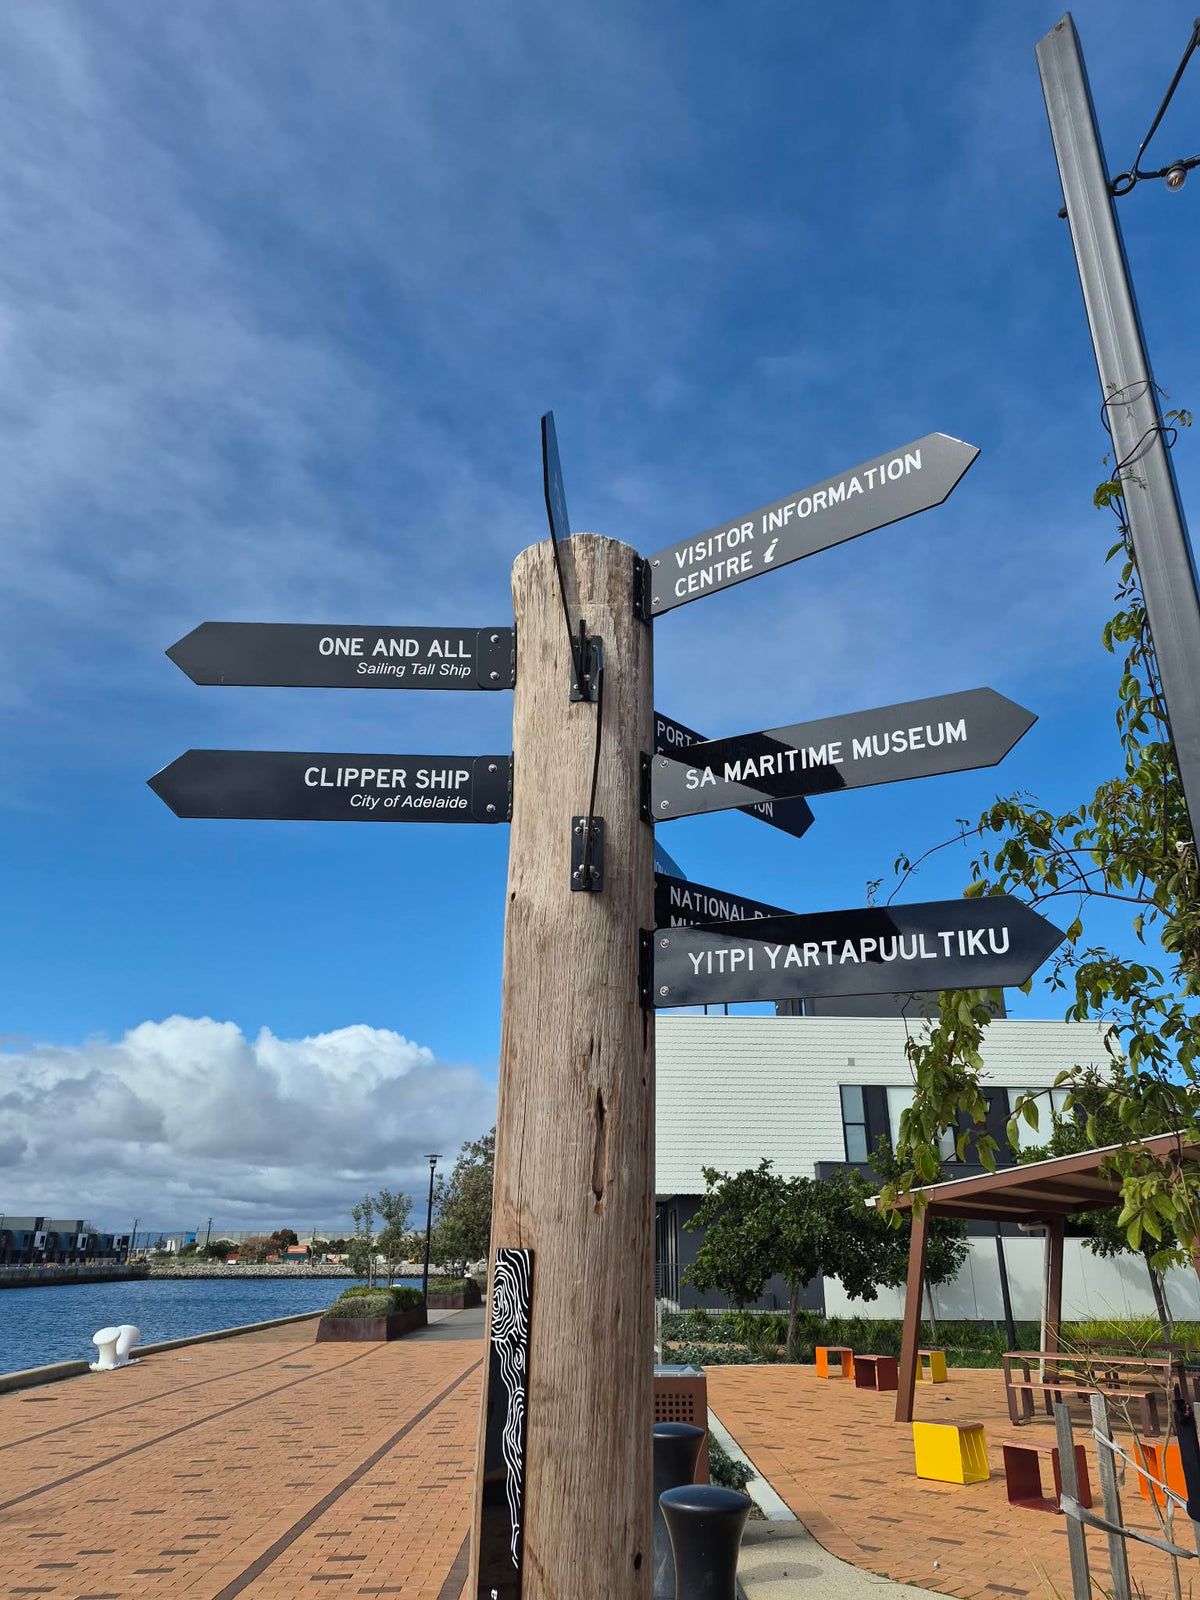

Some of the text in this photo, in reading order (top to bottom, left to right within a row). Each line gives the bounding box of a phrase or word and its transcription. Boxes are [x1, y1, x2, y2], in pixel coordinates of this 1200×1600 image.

[675, 449, 922, 569] VISITOR INFORMATION
[675, 551, 753, 598] CENTRE
[318, 637, 472, 658] ONE AND ALL
[356, 662, 471, 679] Sailing Tall Ship
[657, 720, 692, 747] PORT
[685, 718, 967, 790] SA MARITIME MUSEUM
[304, 767, 470, 790] CLIPPER SHIP
[350, 794, 468, 809] City of Adelaide
[670, 885, 744, 921] NATIONAL
[686, 926, 1010, 975] YITPI YARTAPUULTIKU
